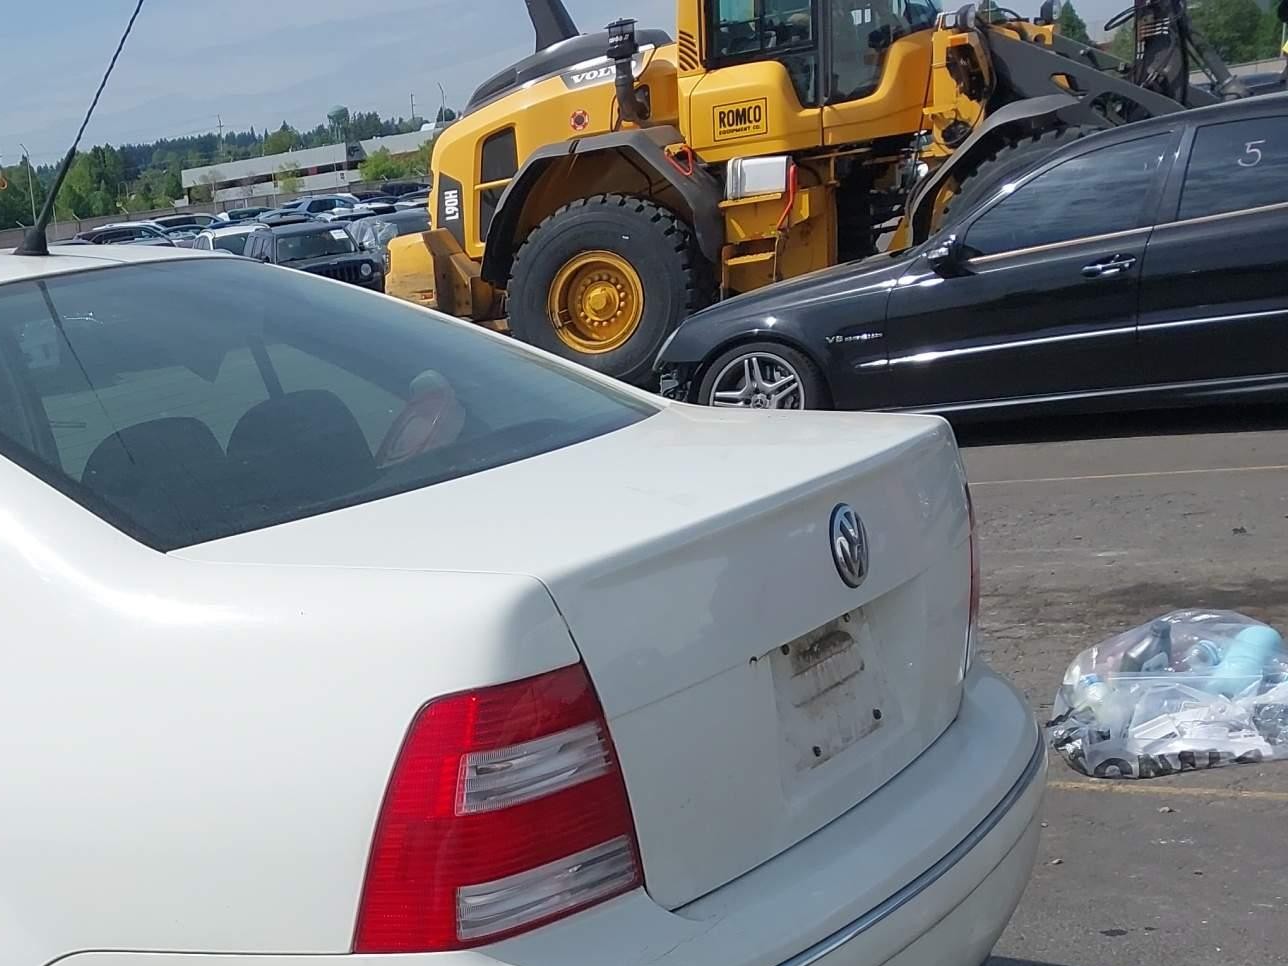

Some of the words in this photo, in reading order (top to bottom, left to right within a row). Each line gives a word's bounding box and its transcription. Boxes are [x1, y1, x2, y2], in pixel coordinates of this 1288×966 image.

[718, 105, 762, 129] ROMCO
[1237, 139, 1266, 167] 5
[444, 189, 459, 221] L90H
